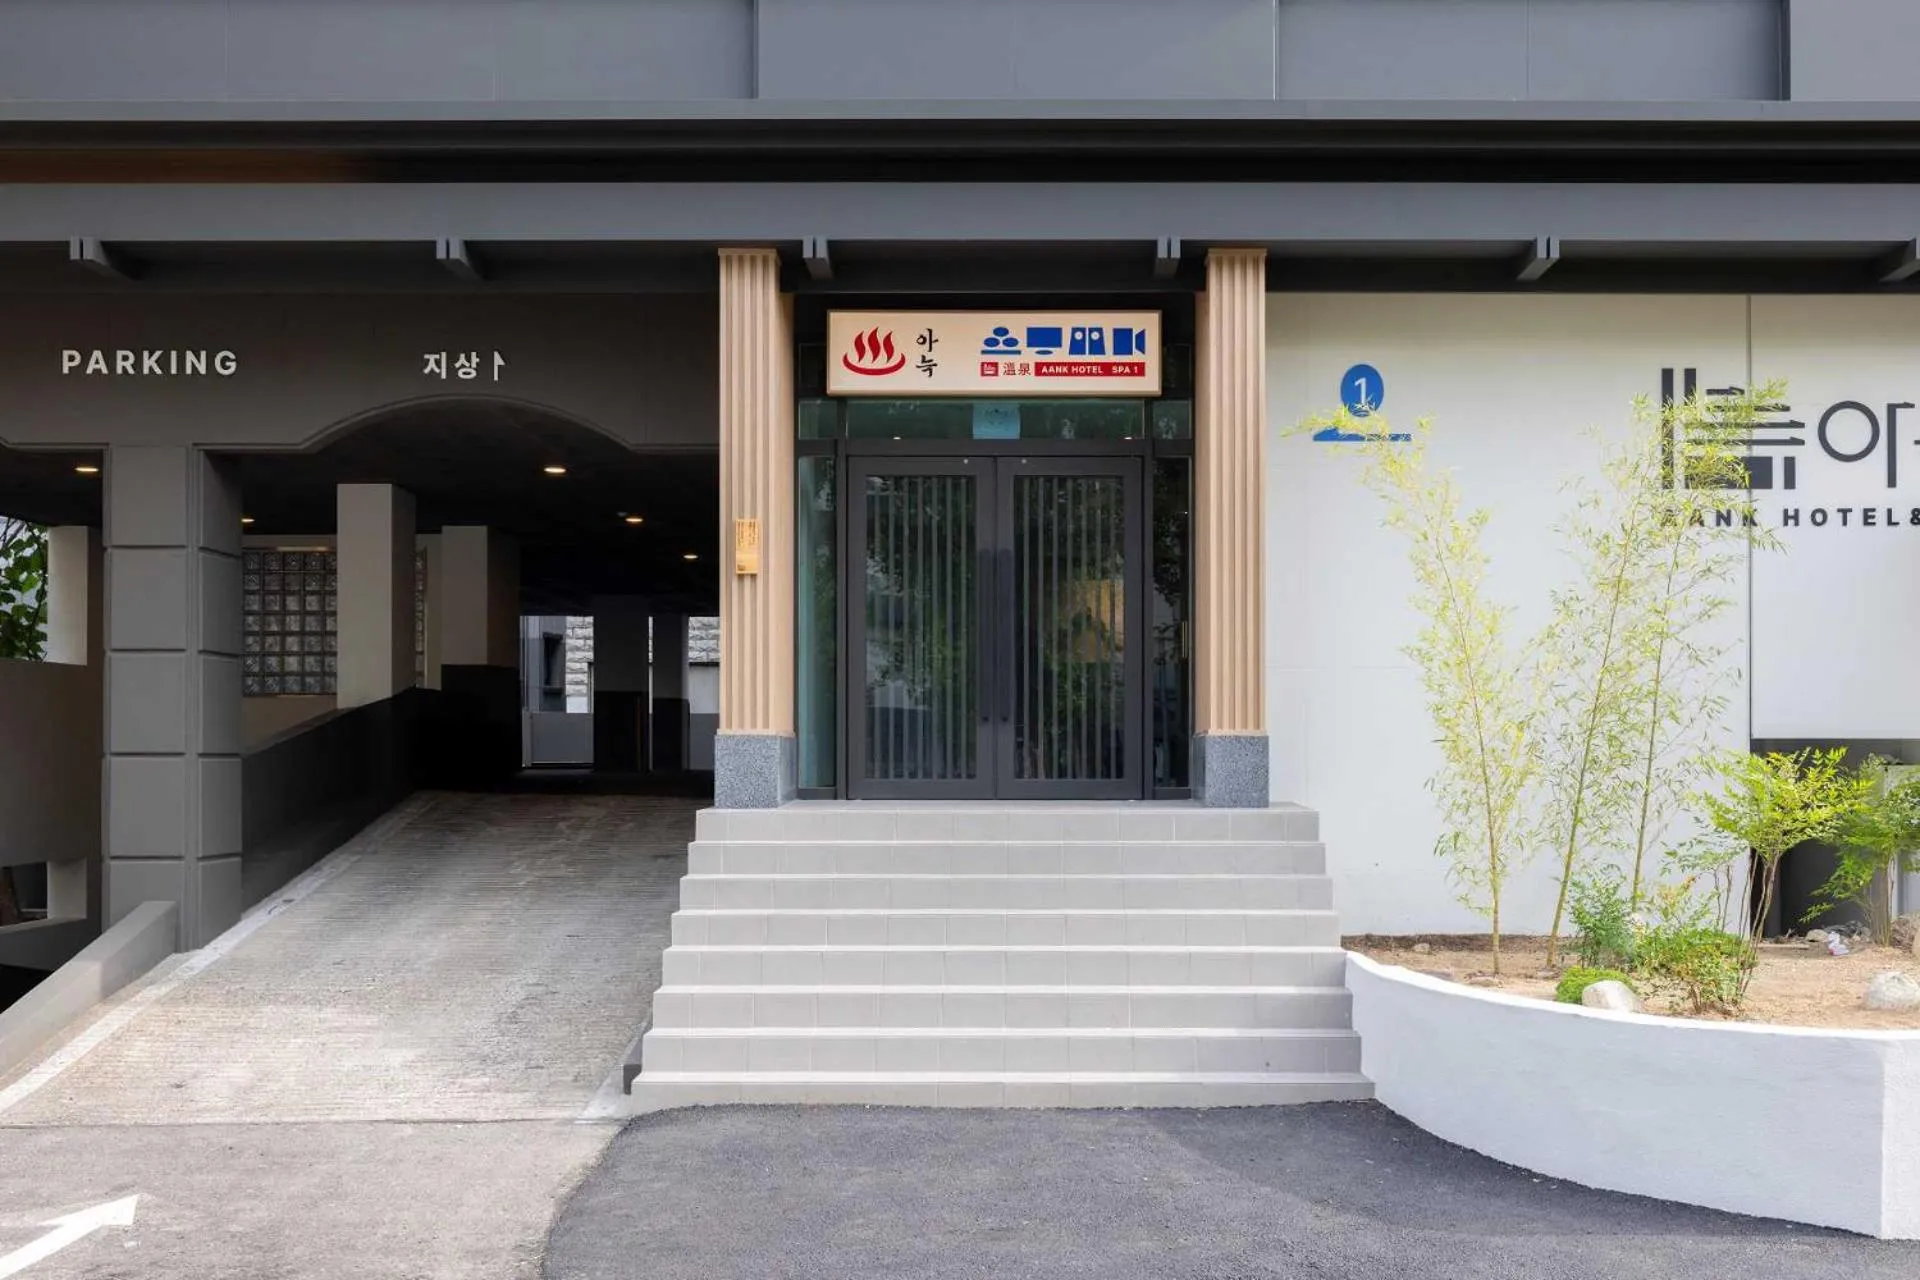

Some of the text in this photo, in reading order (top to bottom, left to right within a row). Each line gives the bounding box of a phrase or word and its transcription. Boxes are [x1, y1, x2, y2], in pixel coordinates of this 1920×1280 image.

[62, 349, 238, 376] PARKING
[423, 351, 480, 379] 지상
[916, 327, 939, 378] 아늑
[1041, 365, 1069, 374] AANK
[1071, 365, 1104, 374] HOTEL
[1111, 365, 1131, 374] SPA
[1354, 377, 1367, 409] 1
